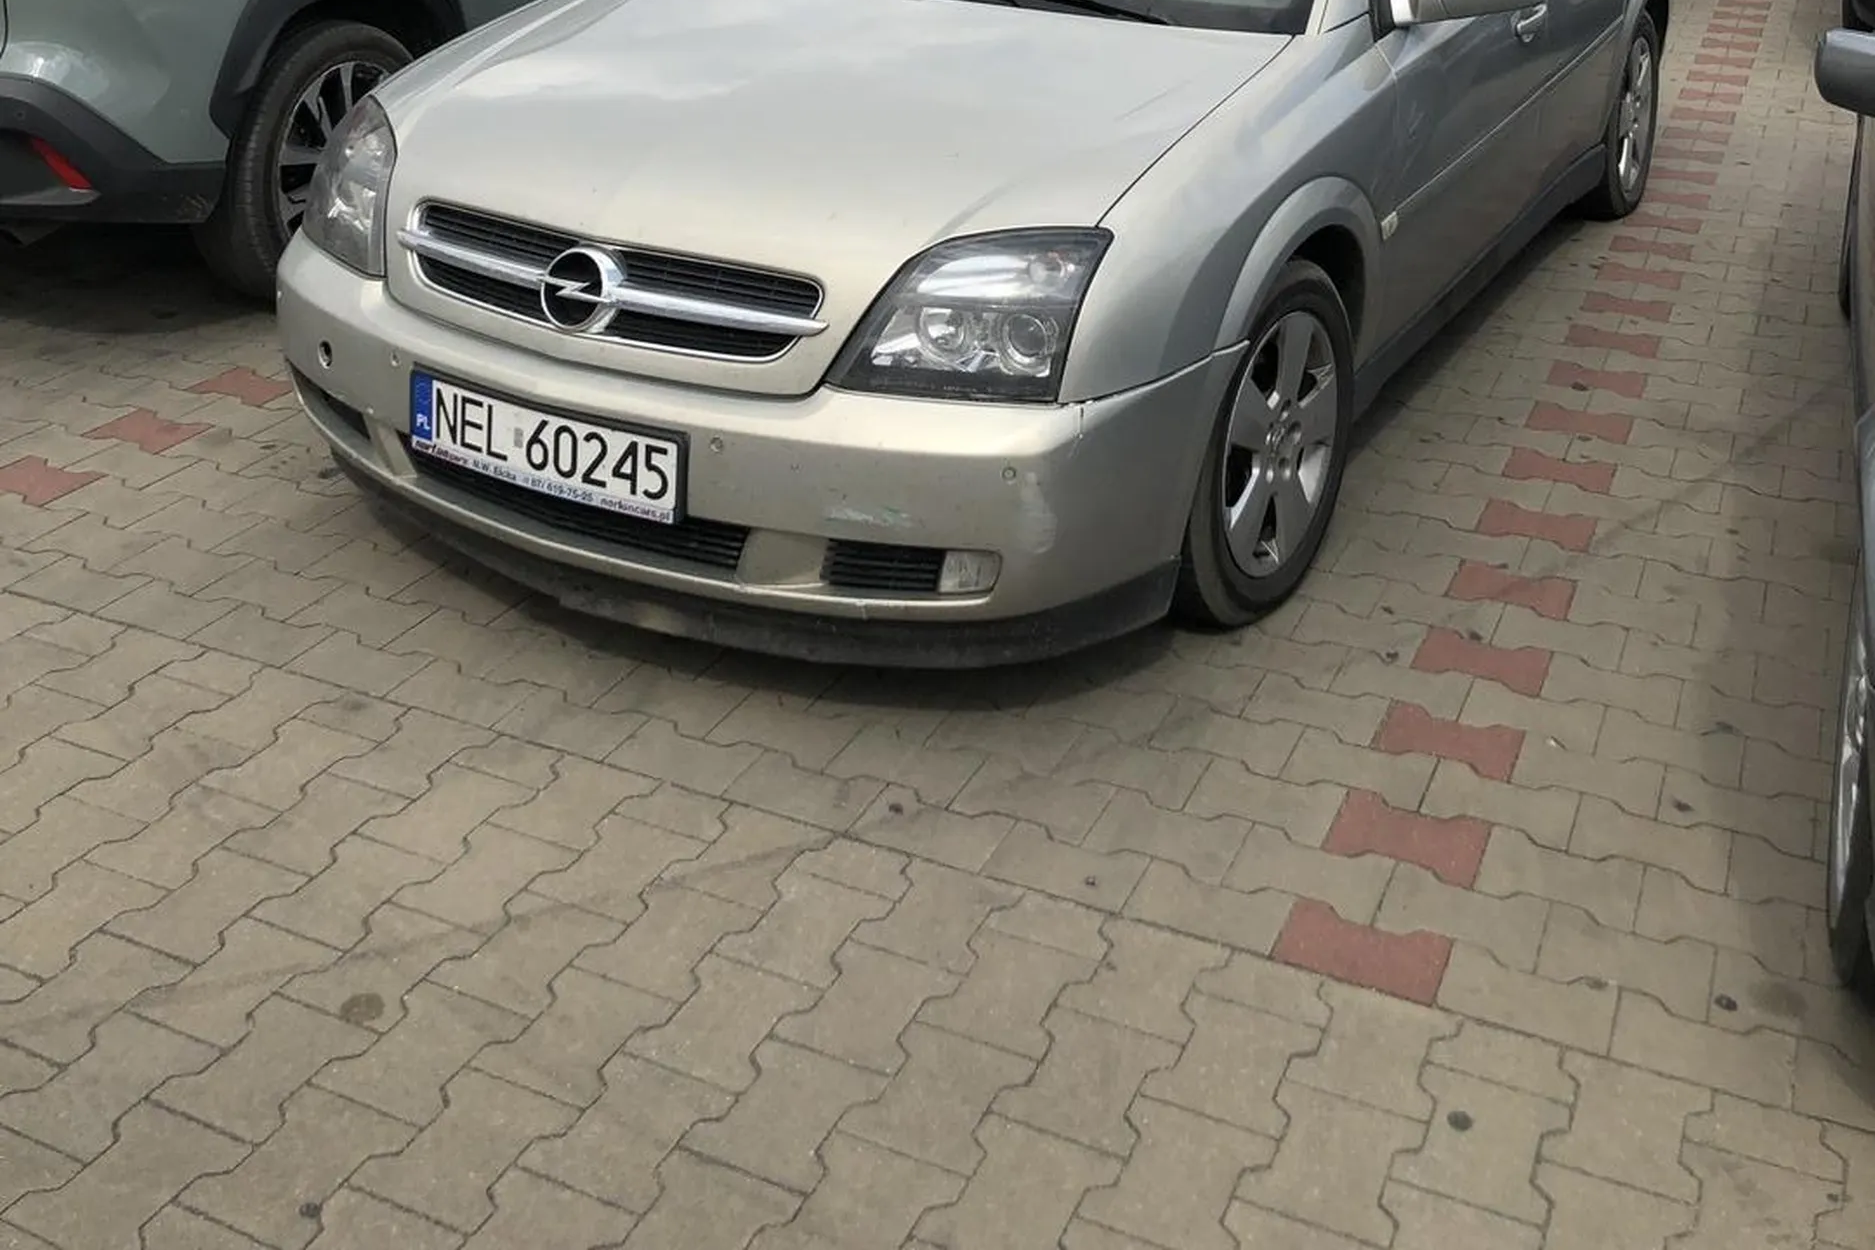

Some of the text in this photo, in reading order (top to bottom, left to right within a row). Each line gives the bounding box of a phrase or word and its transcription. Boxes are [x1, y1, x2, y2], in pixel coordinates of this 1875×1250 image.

[416, 414, 431, 431] PL
[436, 387, 669, 501] NEL 60245
